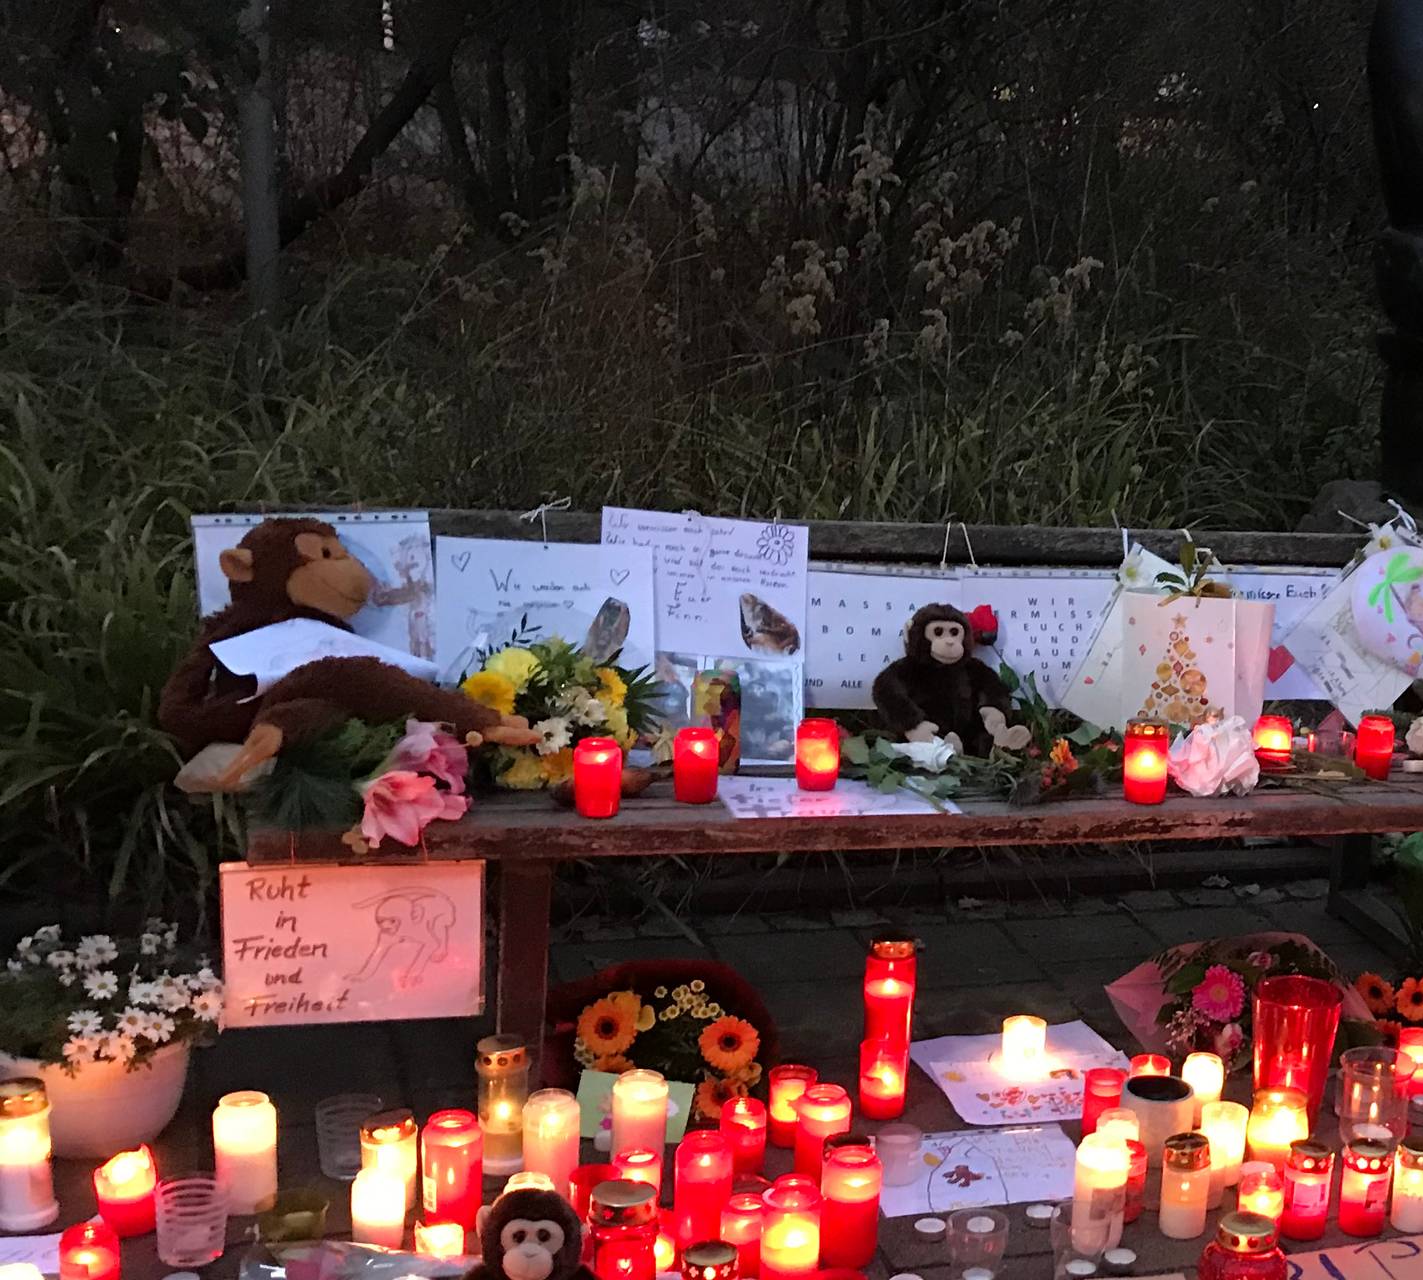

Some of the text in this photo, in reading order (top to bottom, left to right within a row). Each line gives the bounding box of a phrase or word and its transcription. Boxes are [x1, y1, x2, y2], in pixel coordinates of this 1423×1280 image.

[490, 568, 521, 592] Wir
[840, 679, 863, 689] ALLE
[246, 876, 312, 901] Ruht
[275, 911, 297, 932] in
[232, 935, 328, 961] Frieden
[265, 968, 303, 987] und
[244, 989, 350, 1018] Freiheit
